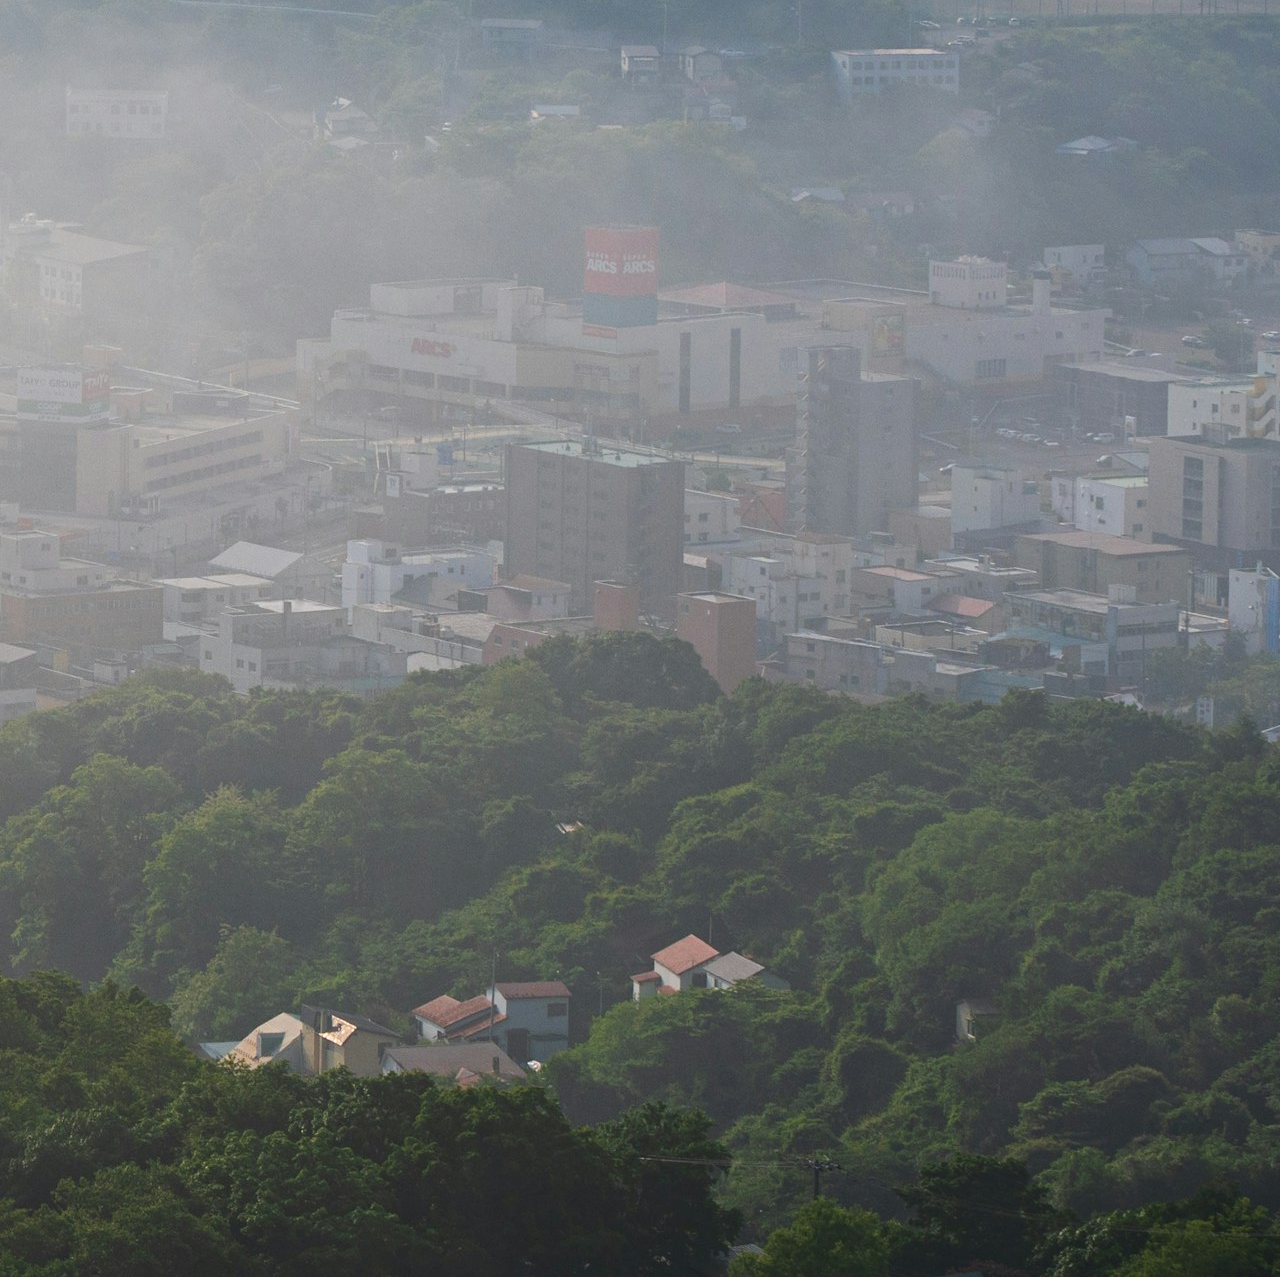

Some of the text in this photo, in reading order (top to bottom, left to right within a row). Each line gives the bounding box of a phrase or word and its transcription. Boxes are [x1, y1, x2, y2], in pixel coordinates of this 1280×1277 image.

[586, 258, 617, 274] ARCS
[622, 259, 655, 275] ARCS
[410, 337, 451, 358] ARCS
[21, 376, 81, 389] TAIYO GROUP
